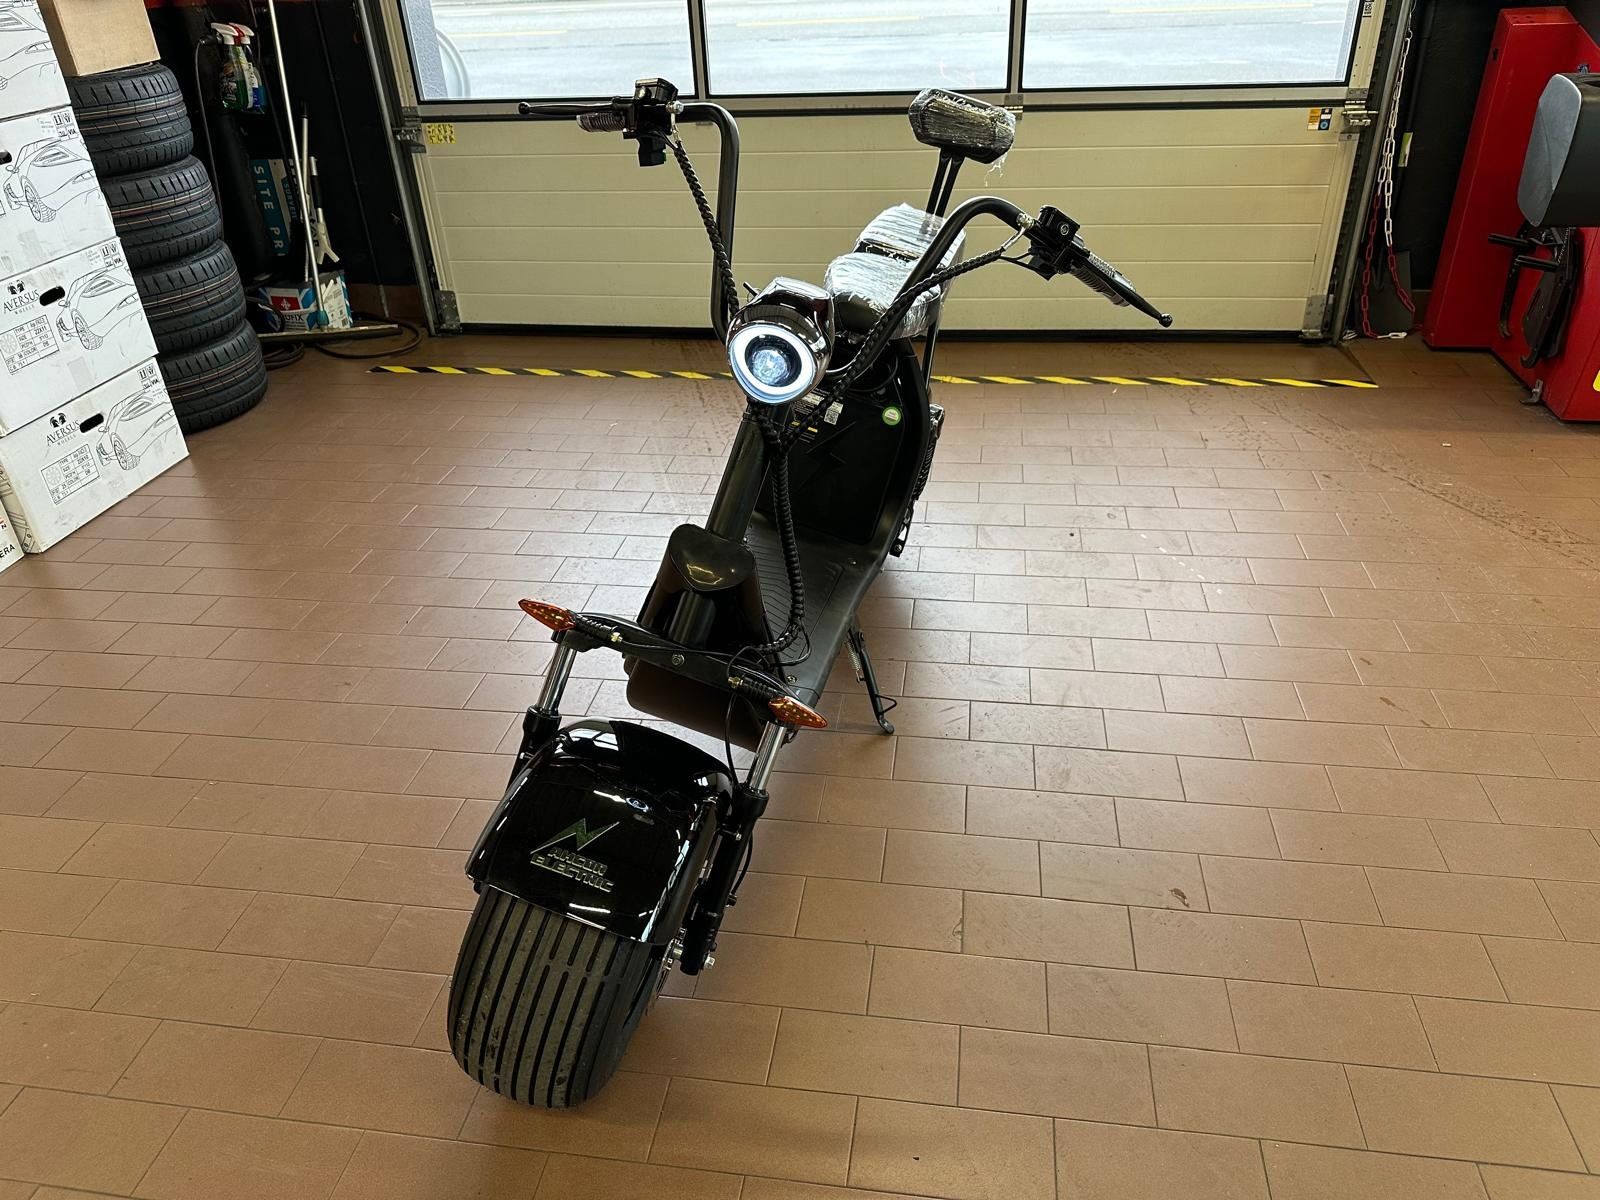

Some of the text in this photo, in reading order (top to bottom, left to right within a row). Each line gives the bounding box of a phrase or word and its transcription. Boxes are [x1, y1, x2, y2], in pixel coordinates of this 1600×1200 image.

[254, 166, 274, 210] SITE
[3, 290, 40, 313] AVERSUS
[46, 420, 81, 446] AVERSUS
[530, 854, 615, 893] ELECTRIC
